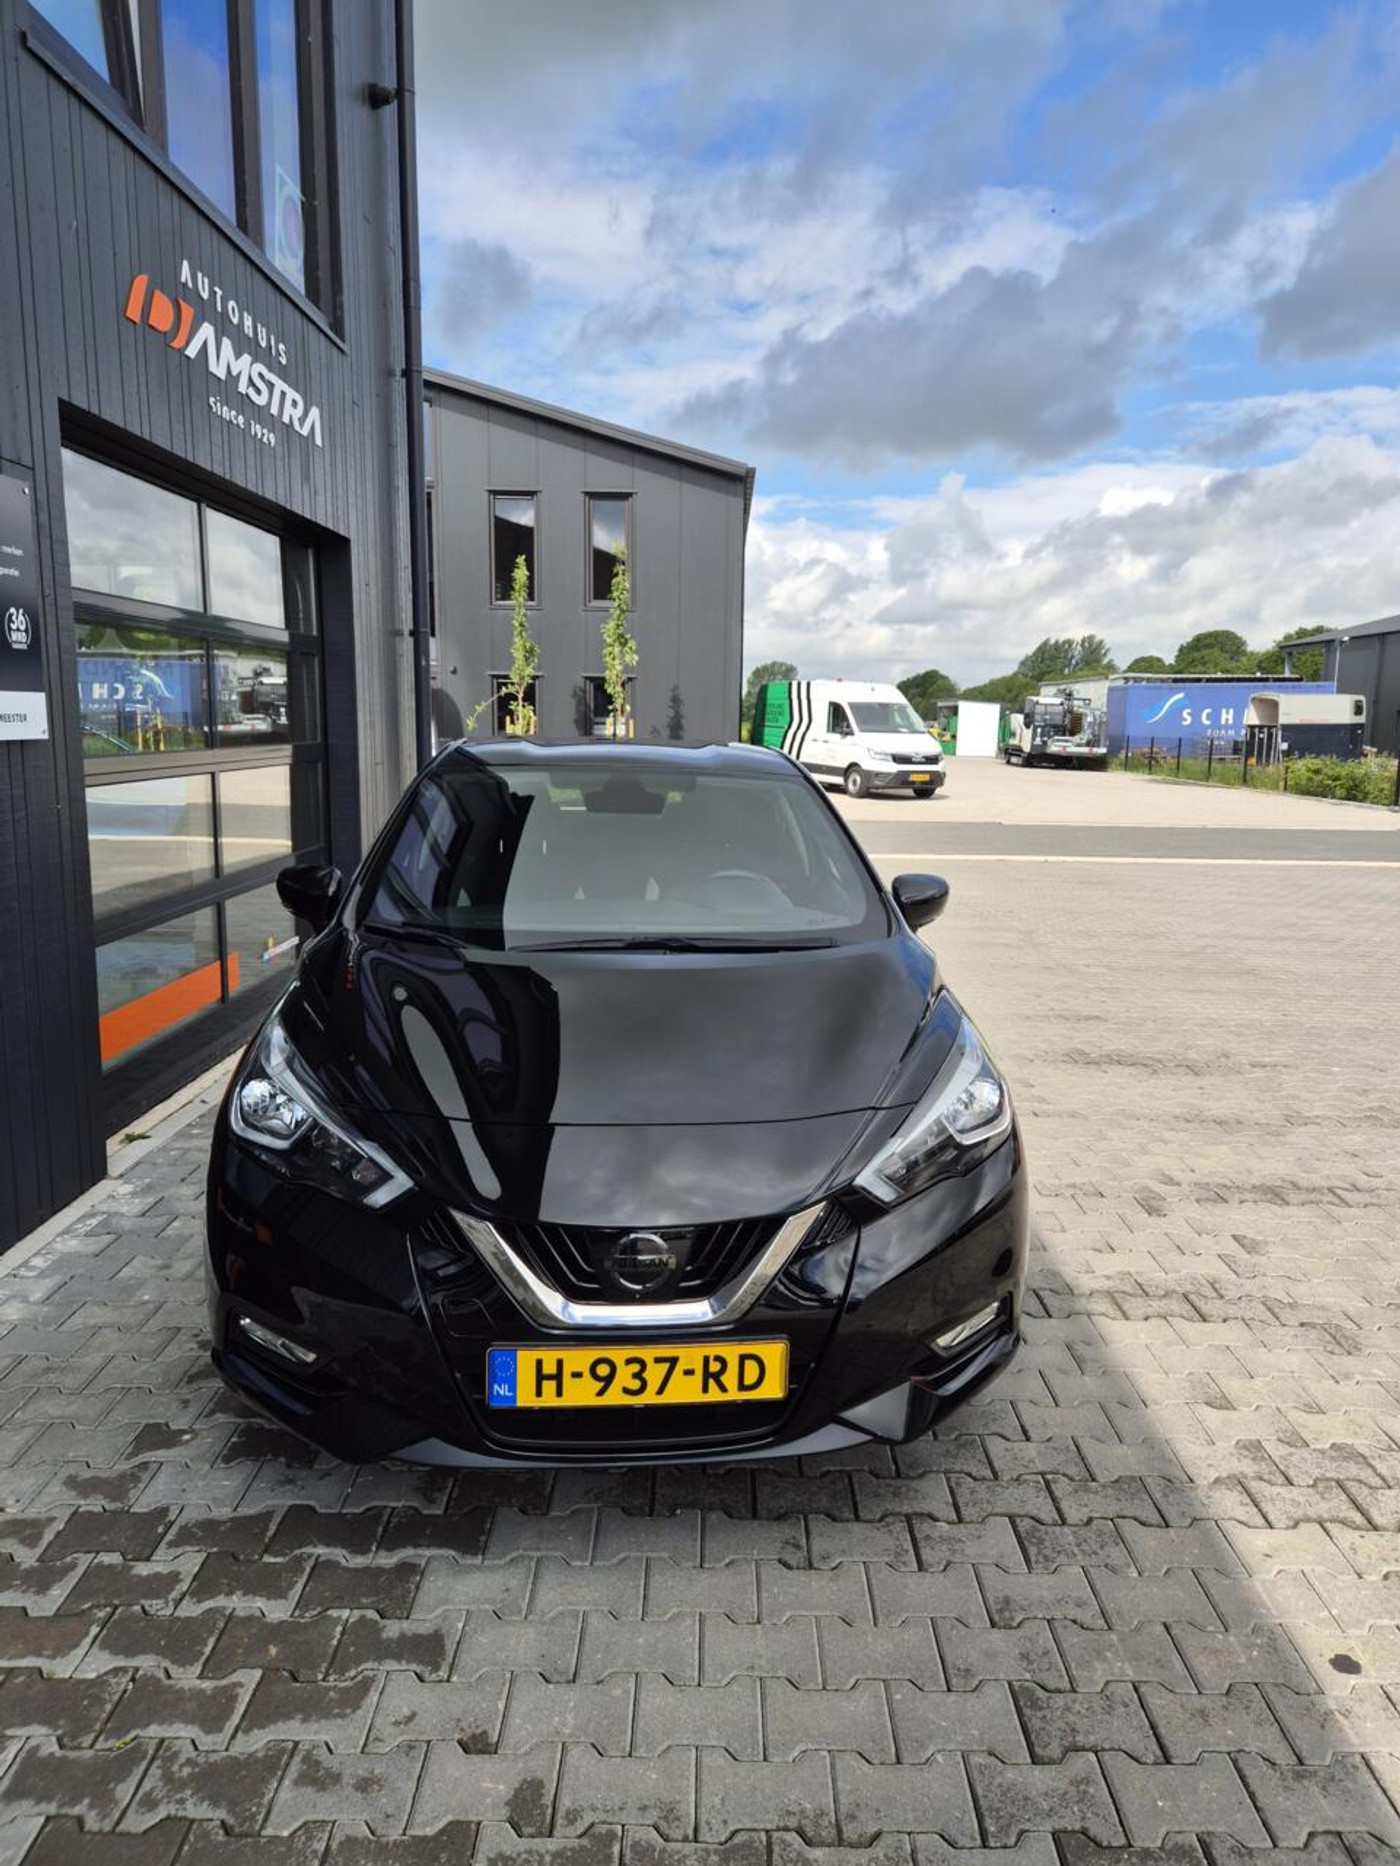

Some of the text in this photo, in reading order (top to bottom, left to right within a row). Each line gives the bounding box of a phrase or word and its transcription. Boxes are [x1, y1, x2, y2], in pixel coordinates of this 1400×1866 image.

[180, 259, 287, 365] AUTOHUIS
[209, 397, 276, 448] since 1929
[9, 606, 27, 631] 36
[493, 1352, 767, 1399] NL H-937-RD
